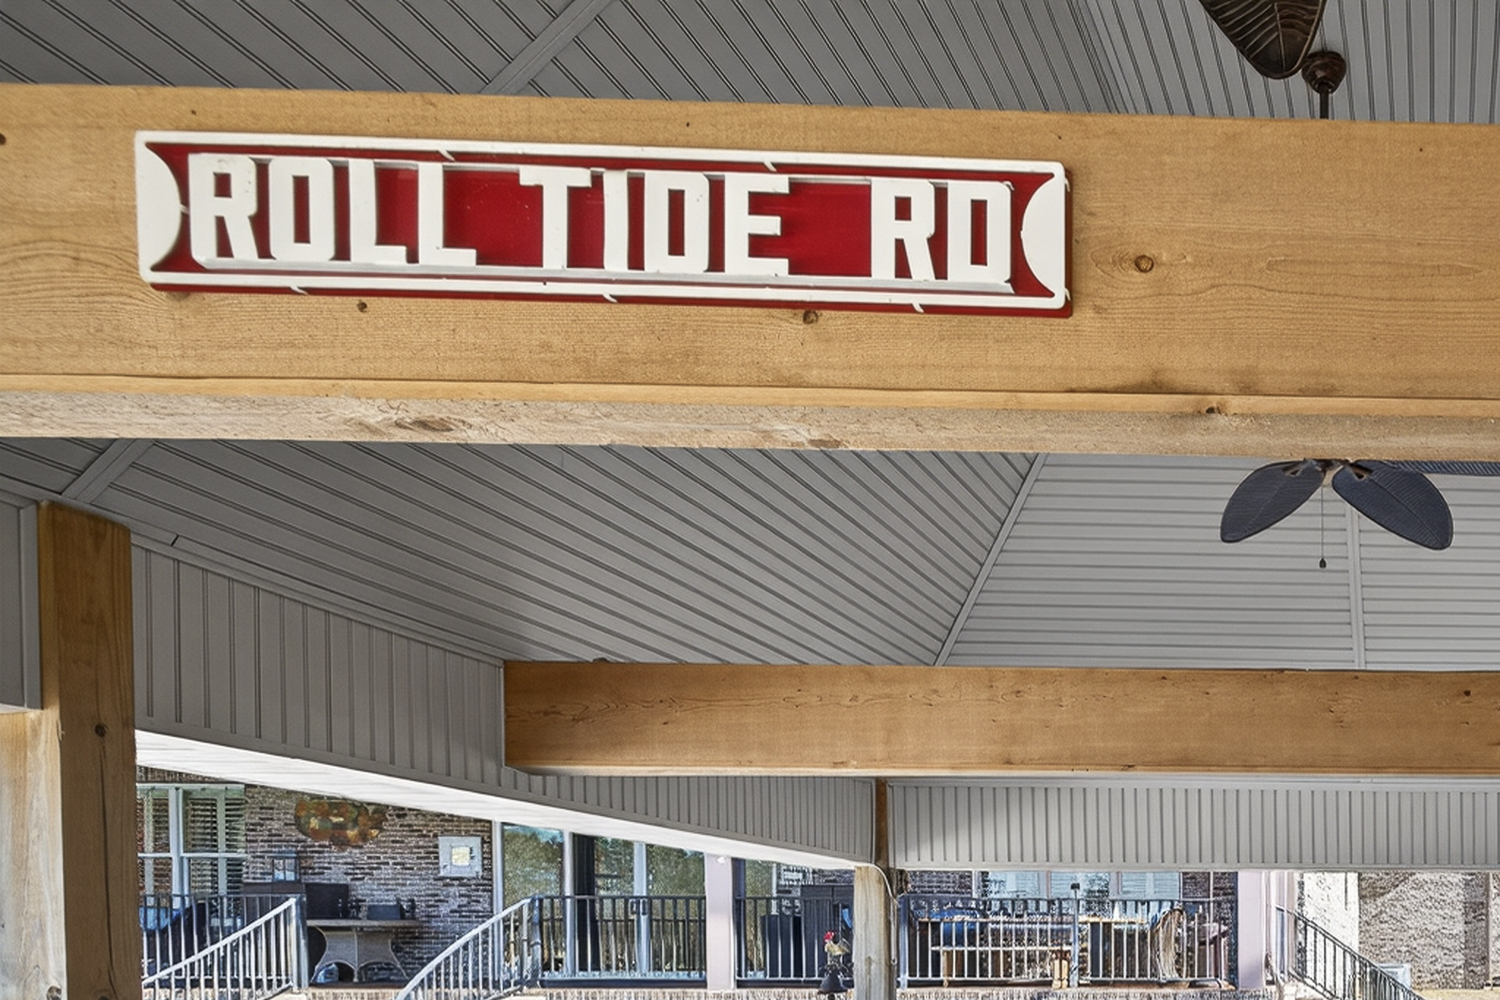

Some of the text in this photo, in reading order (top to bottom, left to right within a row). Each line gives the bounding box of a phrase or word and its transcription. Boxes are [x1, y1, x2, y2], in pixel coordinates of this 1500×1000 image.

[189, 153, 1013, 285] ROLL TIDE RD
